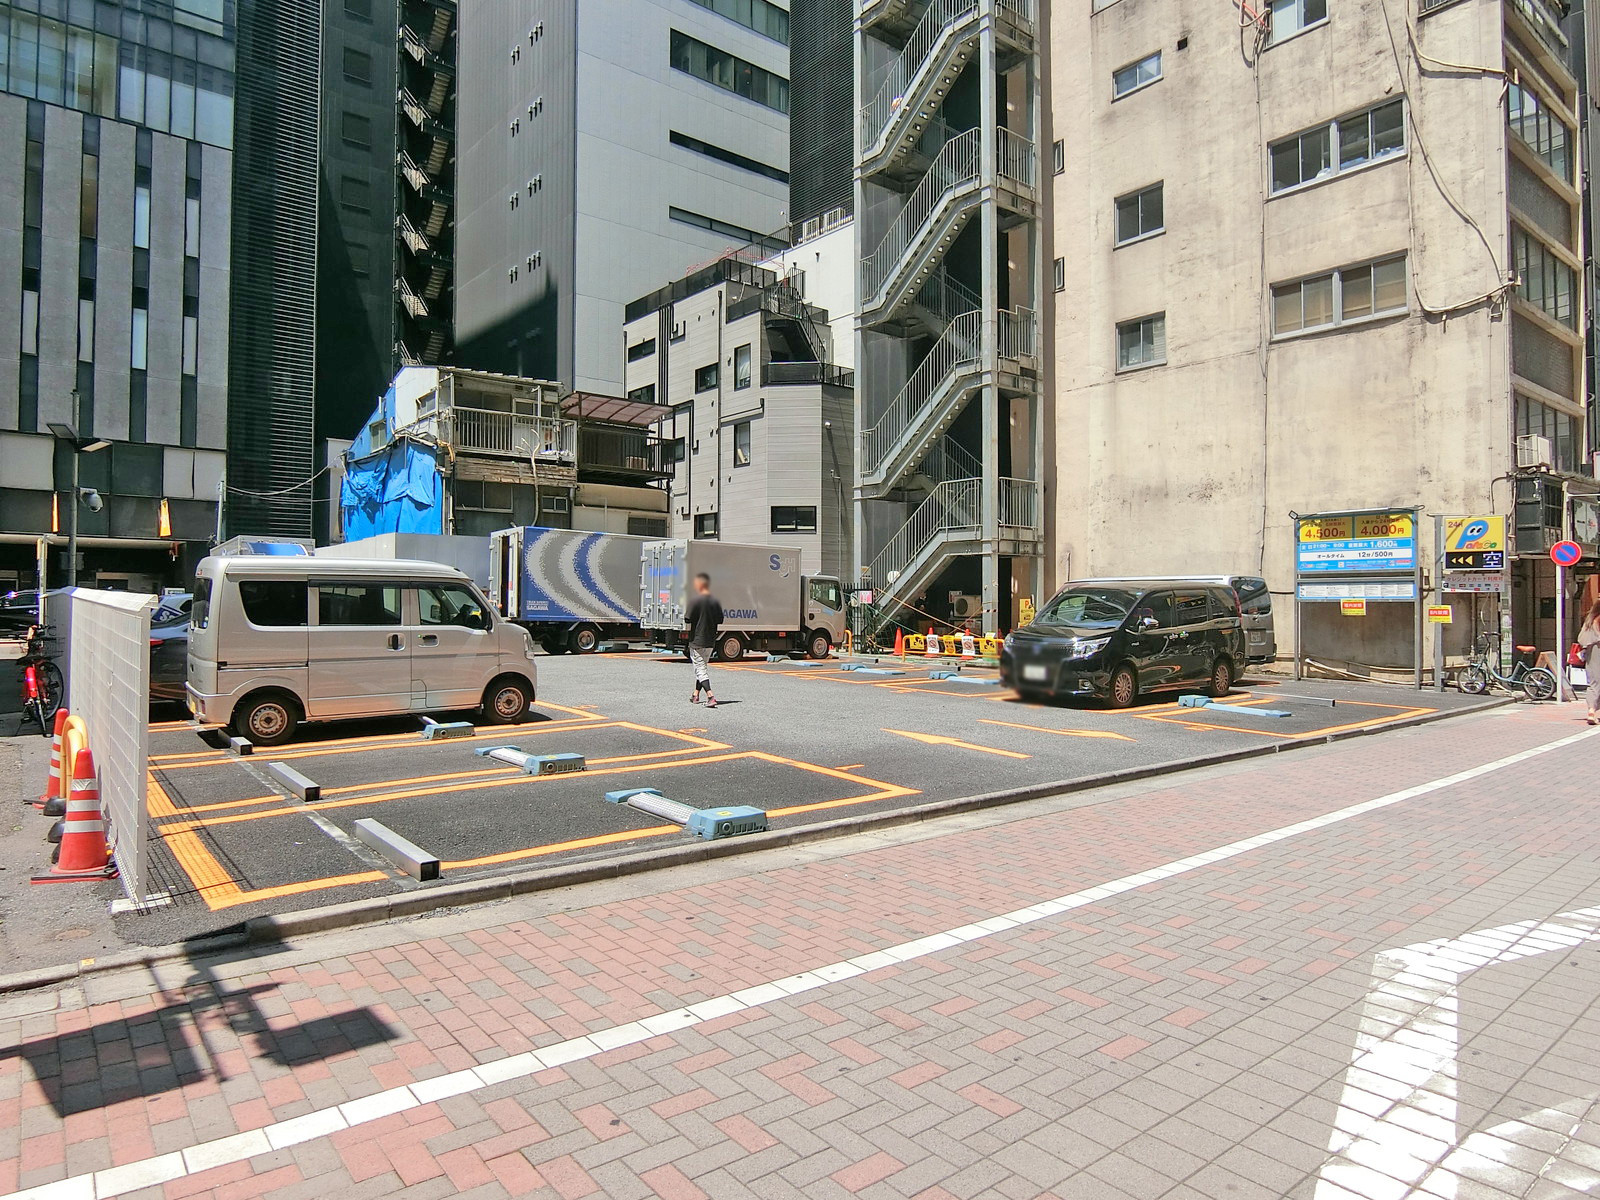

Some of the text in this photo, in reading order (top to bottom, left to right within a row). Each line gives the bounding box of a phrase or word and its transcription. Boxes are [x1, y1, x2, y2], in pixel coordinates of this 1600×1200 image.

[1305, 527, 1346, 539] 4,500円
[1360, 524, 1405, 536] 4,000円
[1482, 551, 1502, 568] 空
[723, 609, 758, 619] AGAWA
